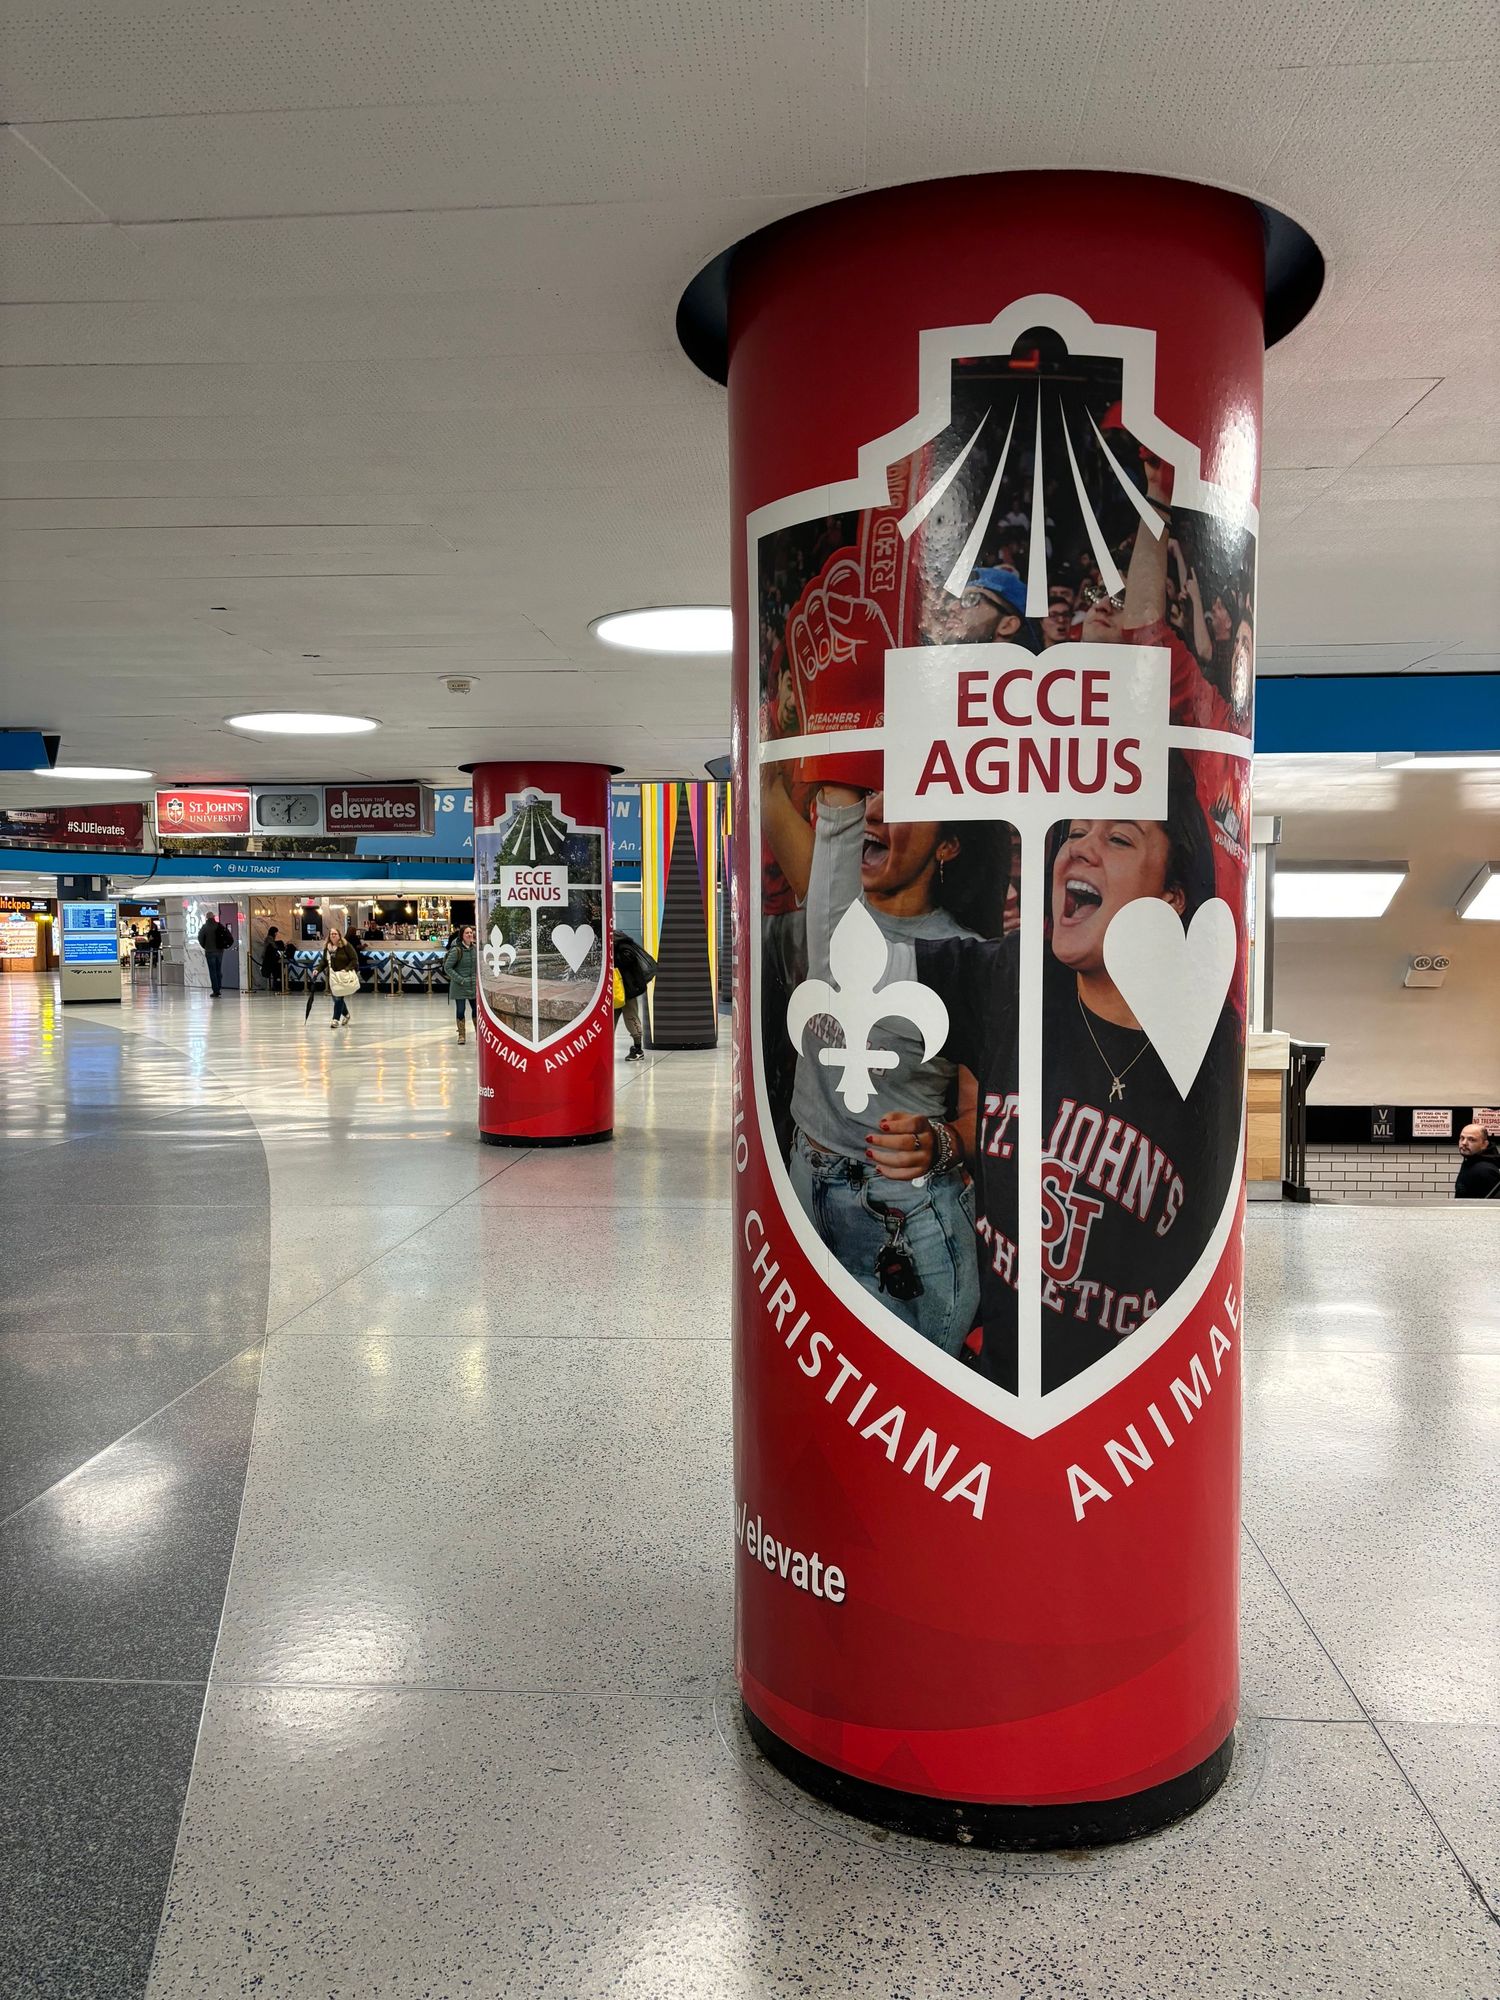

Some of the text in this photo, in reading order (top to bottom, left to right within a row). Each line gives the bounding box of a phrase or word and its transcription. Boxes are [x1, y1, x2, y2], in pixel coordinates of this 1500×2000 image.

[957, 669, 1111, 728] ECCE
[815, 712, 861, 723] TEACHERS
[915, 738, 1142, 796] AGNUS
[189, 801, 244, 815] ST. JOHN'S
[330, 790, 416, 819] elevates
[189, 814, 243, 823] UNIVERSITY
[67, 821, 126, 836] #SJUElevates
[237, 865, 280, 874] NJ TRANSIT
[515, 871, 552, 885] ECCE
[507, 887, 561, 901] AGNUS
[0, 897, 31, 913] hickpea
[544, 1020, 602, 1073] ANIMAE
[1378, 1109, 1388, 1120] V
[1373, 1124, 1393, 1135] ML
[1041, 1098, 1184, 1237] JOHN'S
[743, 1210, 992, 1521] CHRISTIANA
[1066, 1282, 1240, 1522] ANIMAE
